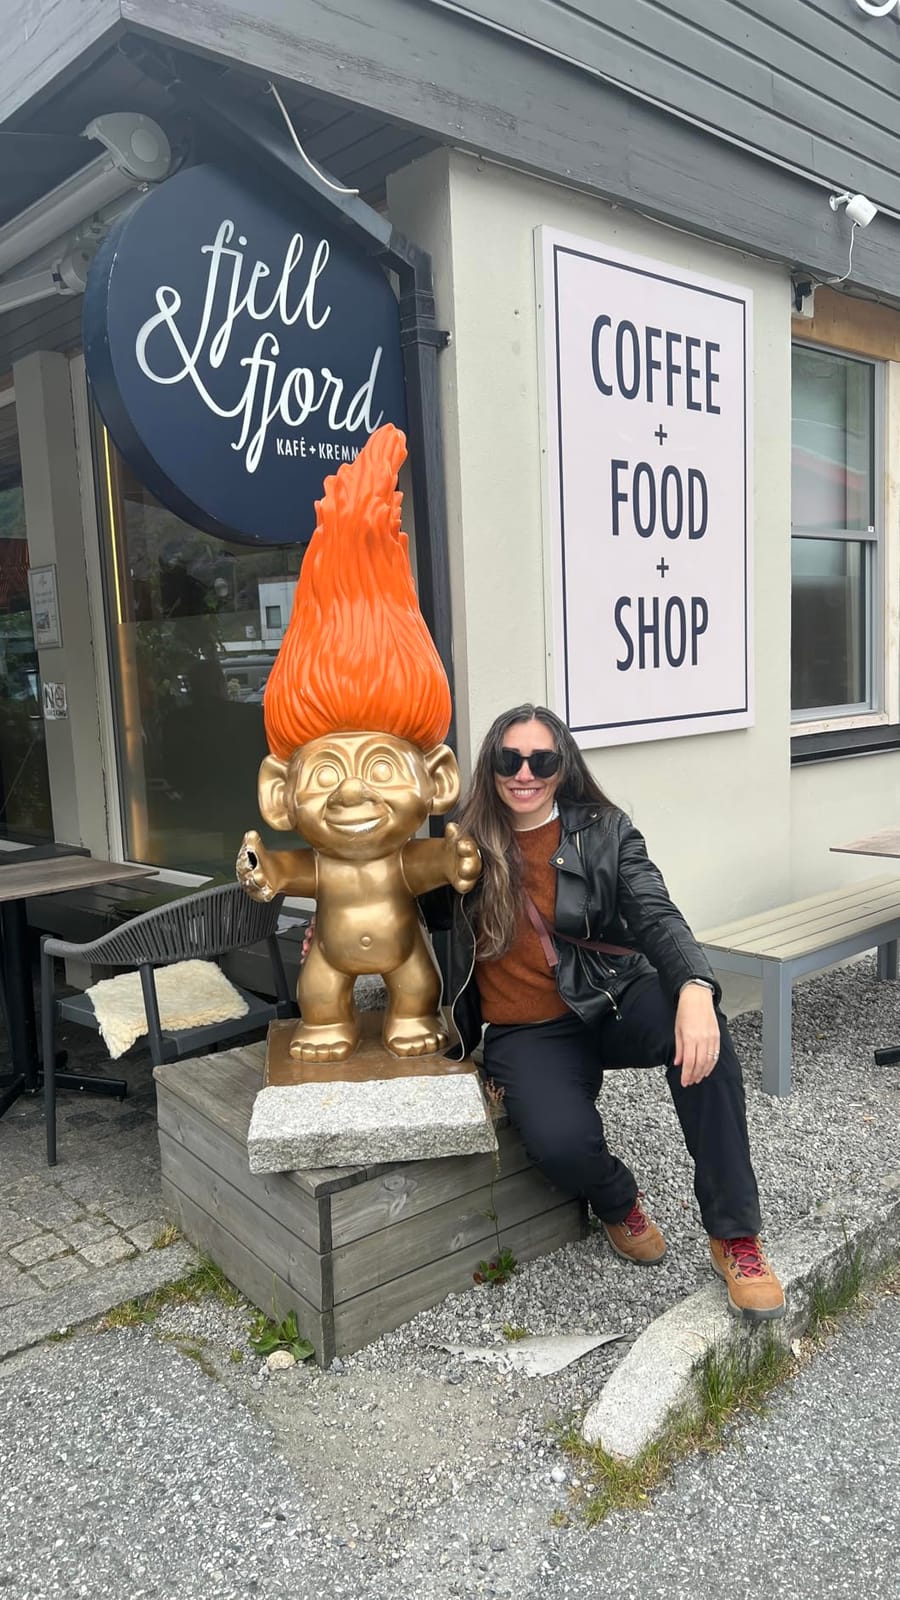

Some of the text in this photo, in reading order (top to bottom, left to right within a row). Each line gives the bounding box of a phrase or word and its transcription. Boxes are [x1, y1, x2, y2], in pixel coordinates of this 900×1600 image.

[201, 219, 332, 369] fjell
[135, 285, 385, 473] & fjord
[591, 314, 721, 415] COFFEE
[276, 436, 307, 458] KAFÉ
[610, 458, 709, 540] FOOD
[614, 595, 709, 672] SHOP
